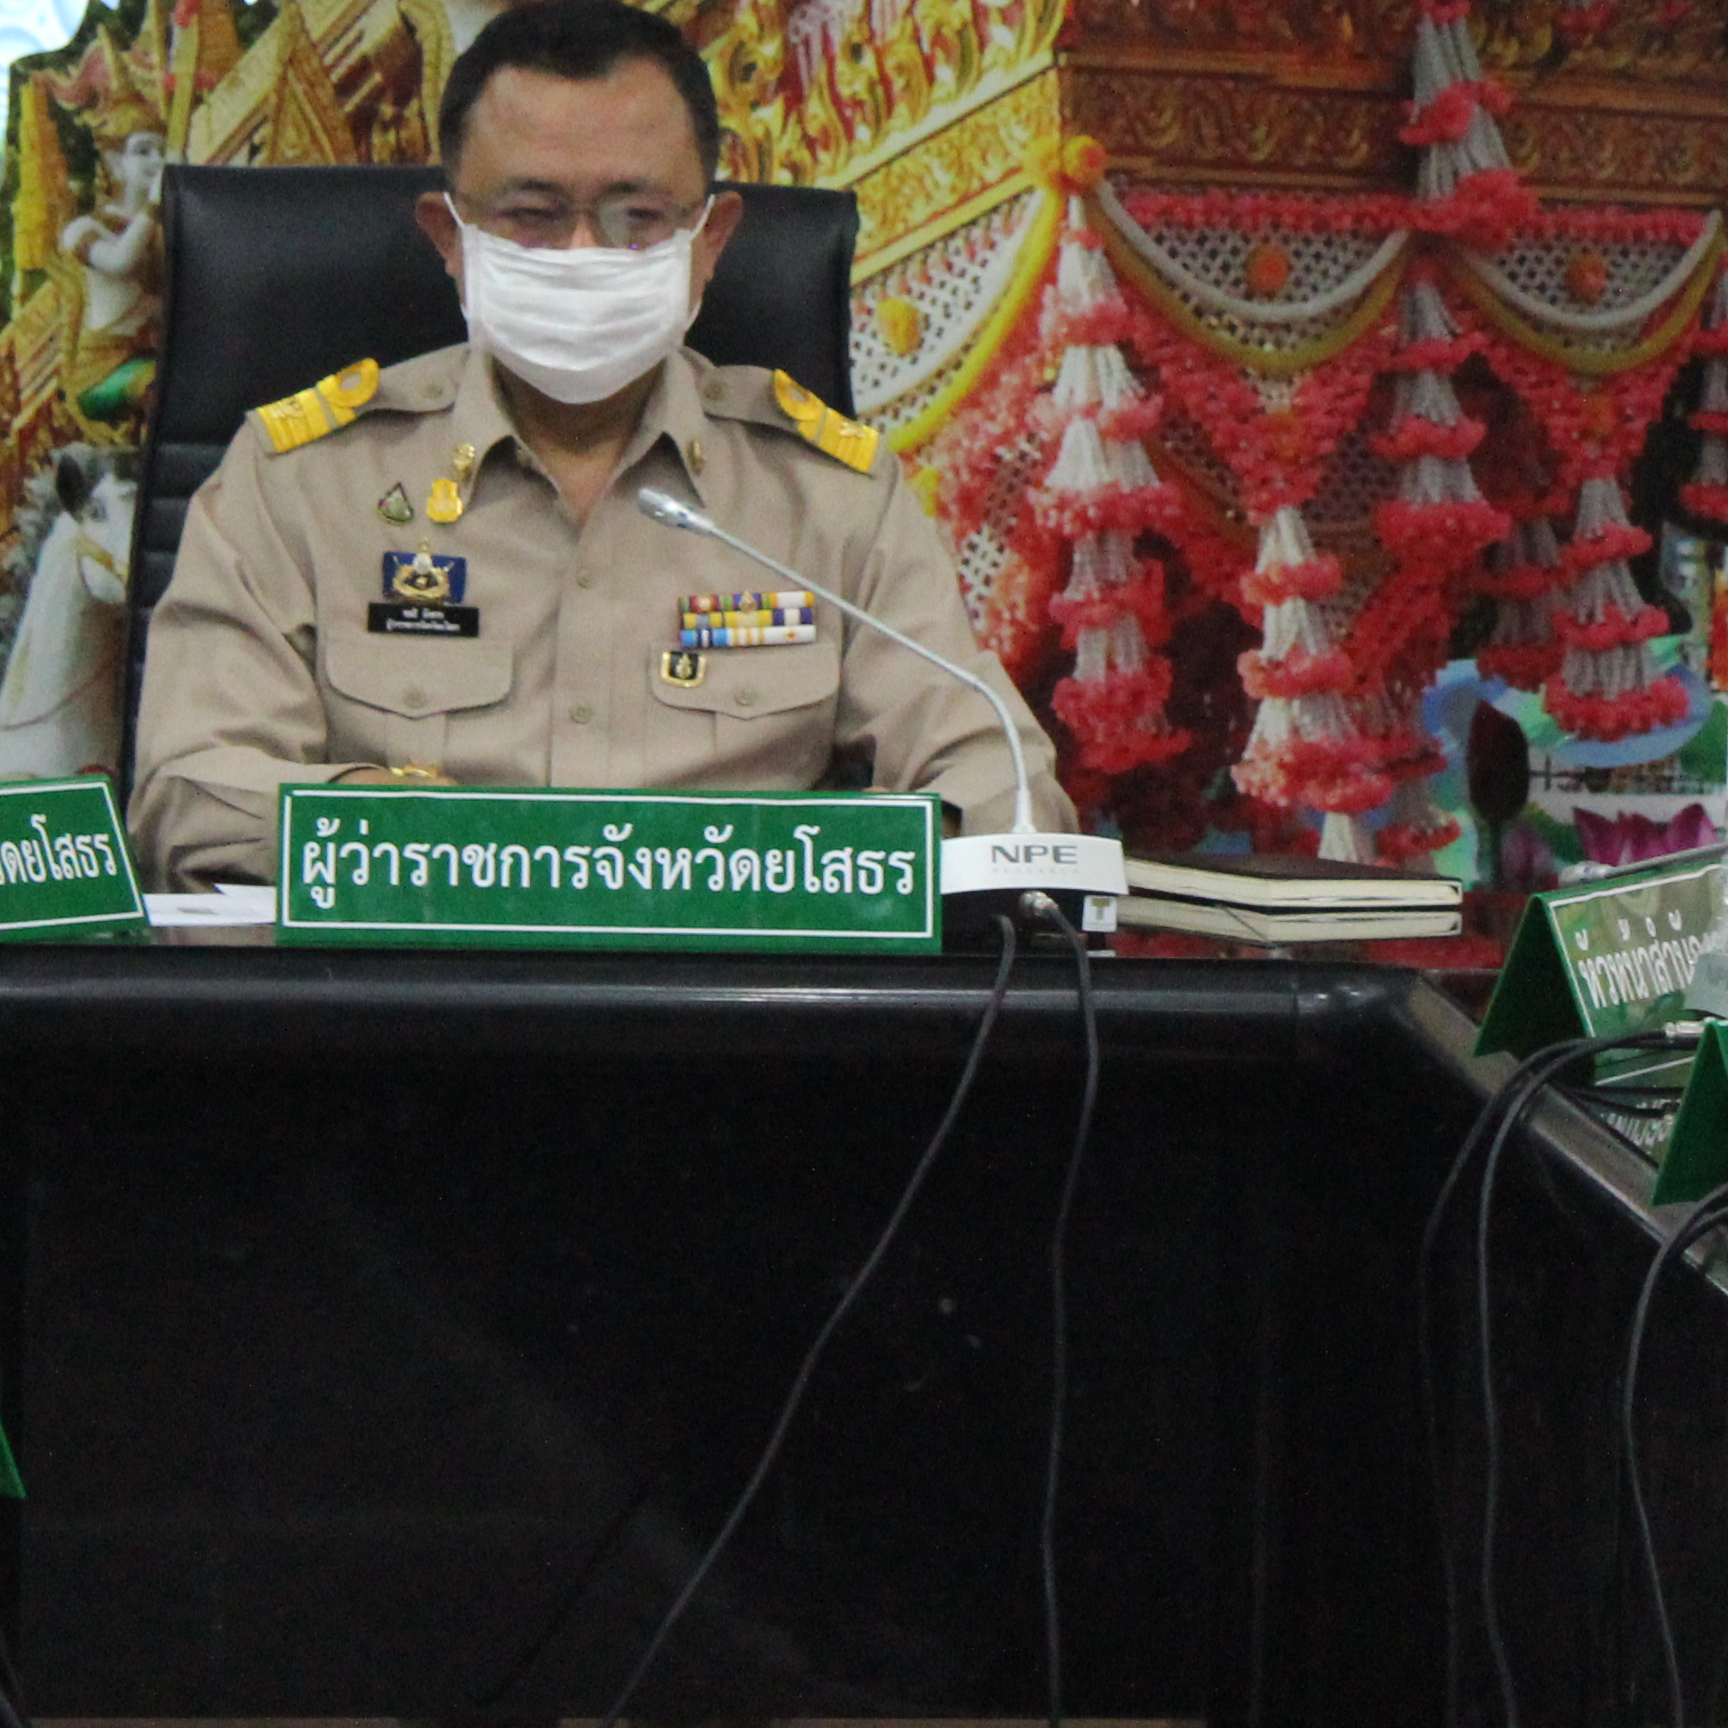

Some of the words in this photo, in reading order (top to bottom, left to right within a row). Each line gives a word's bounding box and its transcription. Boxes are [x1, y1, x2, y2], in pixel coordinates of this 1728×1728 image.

[301, 816, 914, 909] ผู้ว่าราชการจังหวัดยโสธร
[991, 845, 1078, 864] NPE
